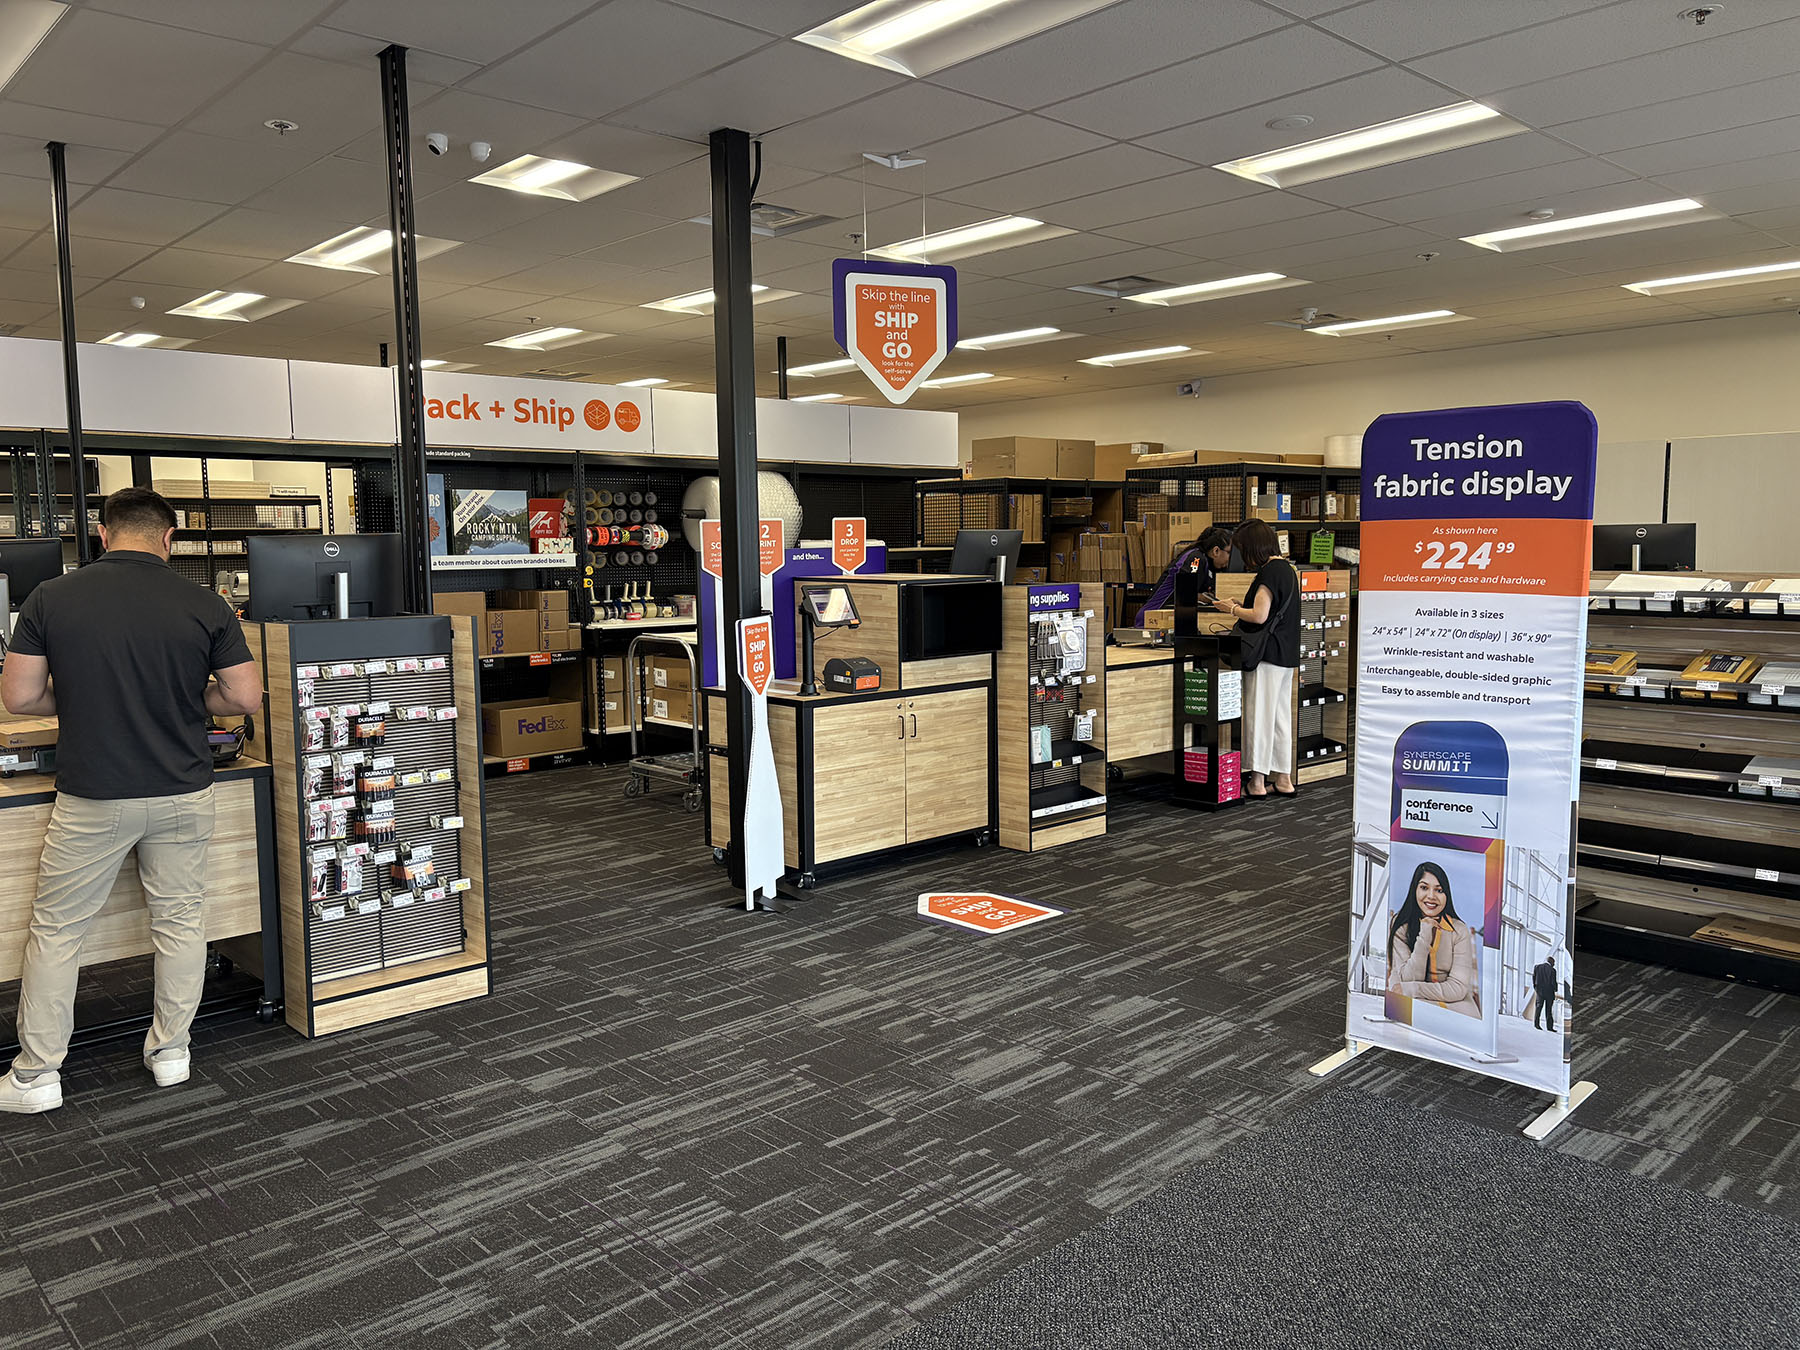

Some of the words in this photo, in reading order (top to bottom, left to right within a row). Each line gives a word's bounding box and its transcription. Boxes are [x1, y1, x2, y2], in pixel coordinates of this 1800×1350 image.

[862, 289, 886, 302] Skip
[889, 290, 908, 302] the
[911, 291, 930, 303] line
[874, 311, 919, 328] SHIP
[886, 330, 908, 340] and
[882, 342, 912, 359] GO
[424, 392, 481, 420] ack
[514, 397, 575, 432] Ship
[1410, 434, 1523, 461] Tension
[1373, 472, 1455, 498] fabric
[1461, 470, 1573, 501] display
[429, 494, 440, 507] RS
[456, 506, 467, 517] Your
[458, 515, 467, 523] On
[466, 505, 476, 516] your
[466, 522, 495, 534] ROCKY
[500, 523, 520, 534] MTN.
[761, 525, 770, 538] 2
[846, 524, 853, 537] 3
[1433, 526, 1444, 535] As
[1446, 526, 1475, 535] shown
[1477, 526, 1498, 535] here
[1383, 574, 1418, 582] Includes
[1420, 575, 1456, 584] carrying
[1480, 576, 1498, 584] and
[1500, 576, 1546, 586] hardware
[1030, 596, 1040, 607] ng
[1040, 591, 1069, 606] supplies
[1415, 608, 1458, 618] Available
[1460, 609, 1469, 618] in
[1471, 610, 1478, 618] 3
[1479, 610, 1504, 620] sizes
[492, 613, 504, 654] FedEx
[1452, 628, 1467, 639] (On
[1469, 630, 1501, 642] display)
[750, 640, 766, 653] SHIP
[1384, 647, 1464, 659] Wrinkle-resistant
[1466, 651, 1484, 660] and
[1486, 652, 1534, 663] washable
[753, 661, 764, 673] GO
[1366, 665, 1443, 679] Interchangeable,
[1445, 670, 1509, 682] double-sided
[1512, 674, 1552, 686] graphic
[1381, 685, 1402, 697] Easy
[1404, 688, 1414, 696] to
[1416, 688, 1460, 700] assemble
[1462, 692, 1480, 701] and
[1482, 693, 1531, 705] transport
[518, 715, 566, 735] FedEx
[1403, 751, 1471, 760] SYNERSCAPE
[1402, 759, 1471, 772] SUMMIT
[365, 769, 392, 778] DURACELL
[1406, 799, 1473, 813] conference
[1406, 810, 1430, 822] hall
[950, 901, 992, 915] SHIP
[976, 907, 998, 915] and
[985, 910, 1016, 920] GO
